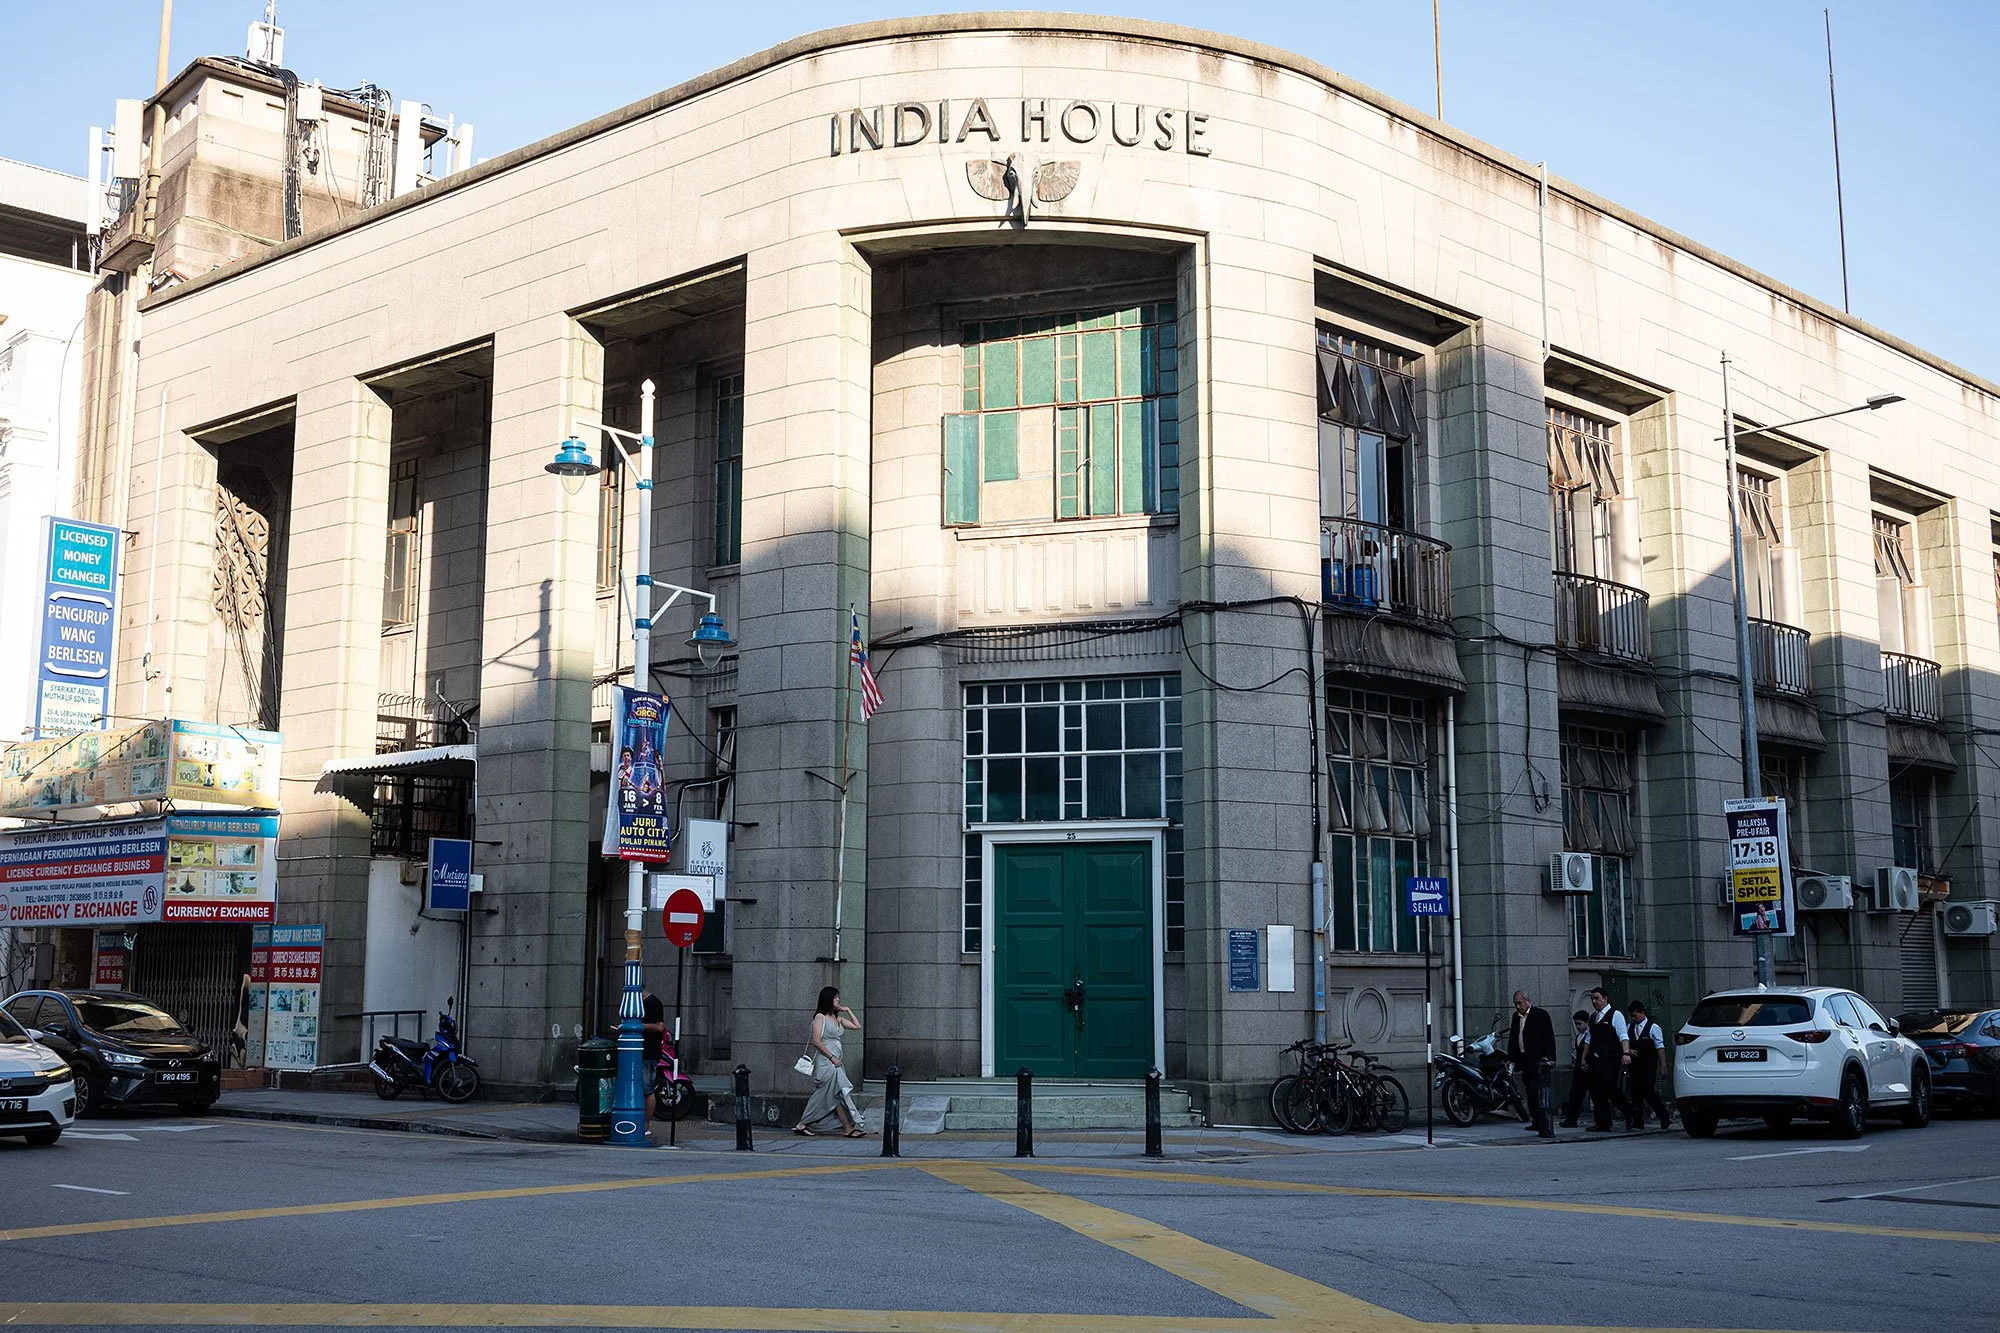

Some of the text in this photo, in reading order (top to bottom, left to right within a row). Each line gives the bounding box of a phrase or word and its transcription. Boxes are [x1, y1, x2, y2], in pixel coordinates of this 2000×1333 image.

[831, 97, 1212, 157] INDIA HOUSE
[60, 529, 108, 547] LICENSED
[63, 549, 102, 565] MONEY
[57, 567, 106, 585] CHANGER
[48, 604, 110, 626] PENGURUP
[60, 626, 96, 644] WANG
[48, 645, 104, 665] BERLESEN
[50, 684, 77, 694] SYARIKAT
[623, 790, 662, 804] 16 8
[171, 819, 206, 831] PENGURUP
[207, 821, 226, 832] WANG
[632, 817, 657, 827] JURU
[1737, 818, 1768, 828] MALAYSIA
[14, 834, 46, 845] SYARIKAT
[47, 831, 69, 842] ABDUL
[71, 828, 107, 840] MUTHALIF
[109, 827, 126, 837] SDN.
[128, 825, 146, 836] BHD.
[620, 826, 668, 839] AUTO CITY,
[1066, 832, 1076, 840] 25
[1736, 827, 1770, 837] PRE-U FAIR
[620, 837, 643, 845] PULAU
[0, 842, 160, 863] PERNIAGAAN PERKHIDMATAN WANG BERLESEN
[1733, 841, 1775, 858] 17 18
[6, 860, 150, 878] LICENSE CURRENCY EXCHANGE BUSINESS
[690, 864, 724, 875] LUCKY TOURS
[1415, 880, 1440, 891] JALAN
[1741, 876, 1771, 885] SETIA
[1738, 886, 1777, 898] SPICE
[10, 900, 138, 920] CURRENCY EXCHANGE
[167, 906, 269, 918] CURRENCY EXCHANGE
[1412, 902, 1443, 913] SEHALA
[1724, 1051, 1760, 1059] VEP 6223
[176, 1073, 191, 1081] 4195
[9, 1100, 23, 1110] 716
